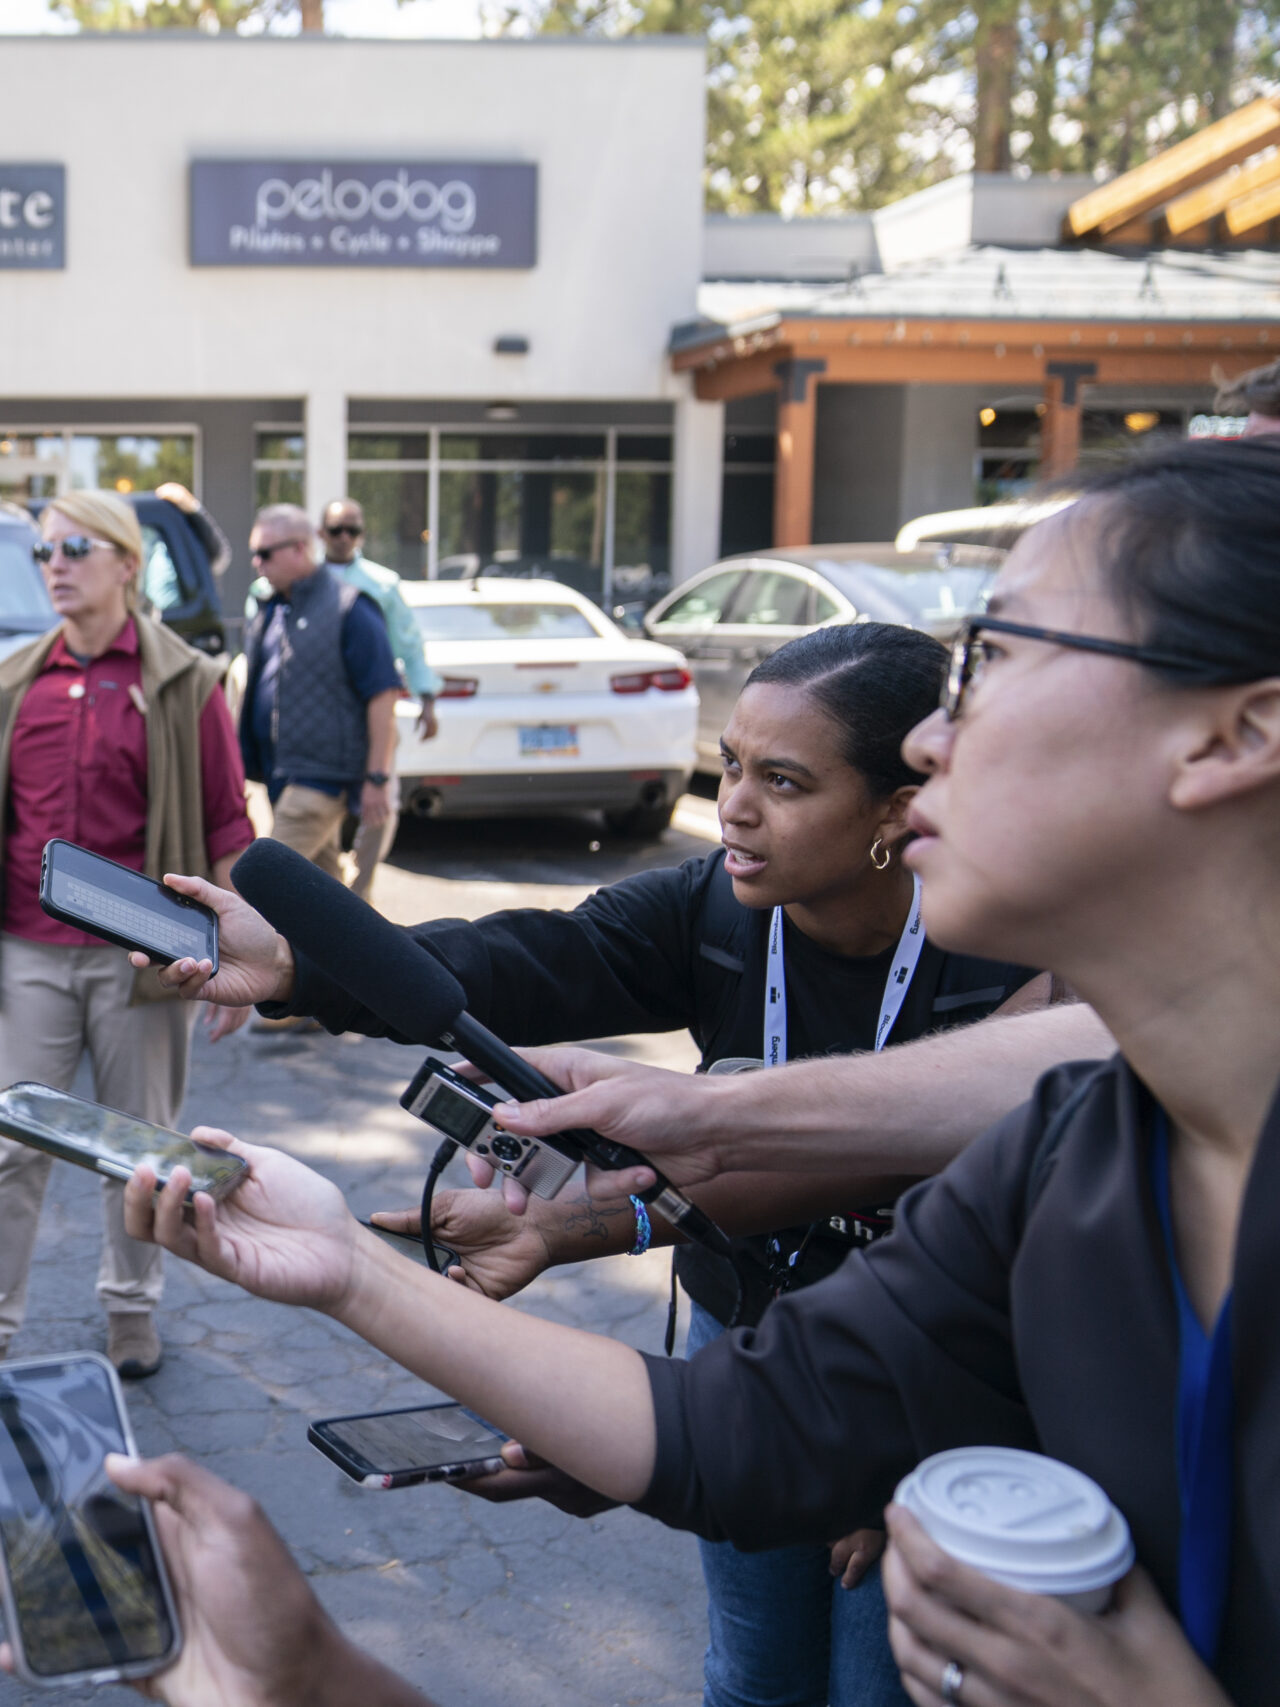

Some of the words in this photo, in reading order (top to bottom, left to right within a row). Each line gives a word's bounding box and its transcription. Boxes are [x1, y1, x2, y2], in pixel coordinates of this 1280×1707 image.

[256, 167, 477, 233] pelodog
[229, 224, 307, 254] Pilates
[329, 224, 392, 258] Cycle
